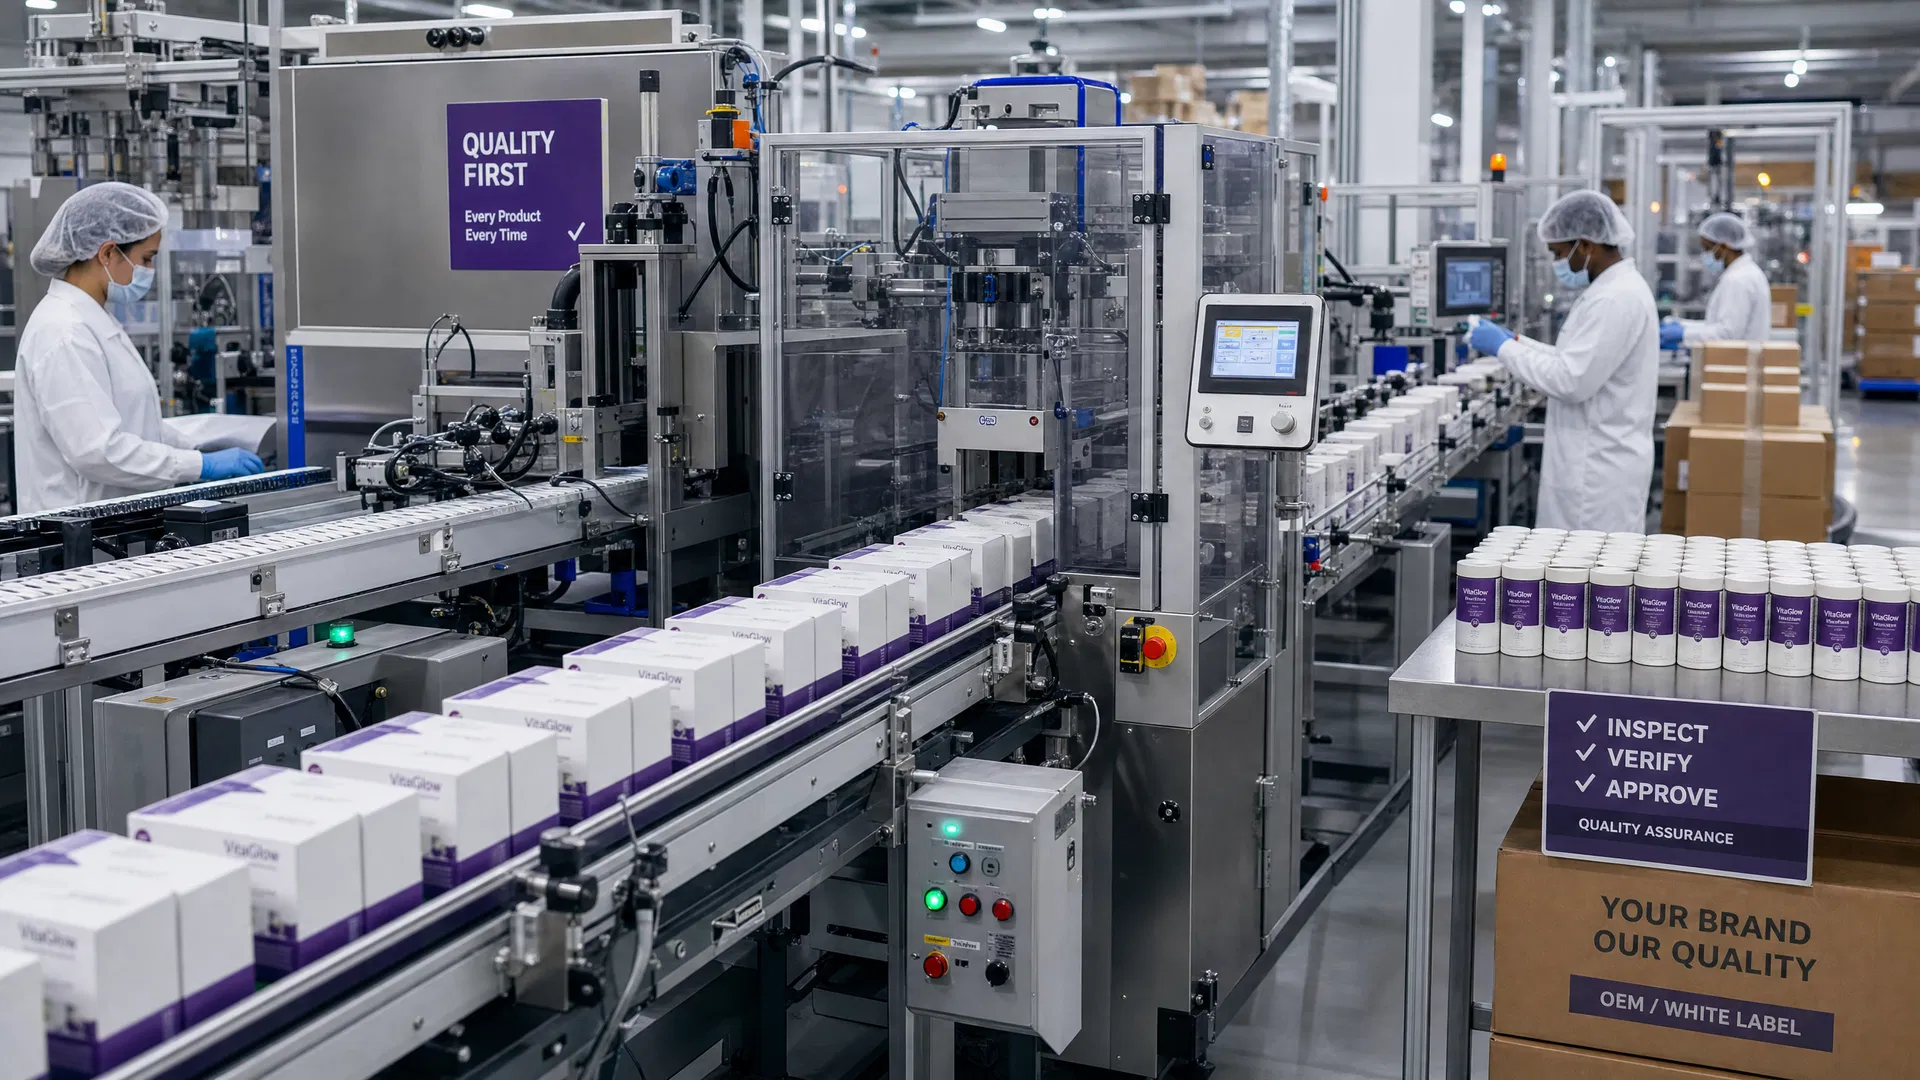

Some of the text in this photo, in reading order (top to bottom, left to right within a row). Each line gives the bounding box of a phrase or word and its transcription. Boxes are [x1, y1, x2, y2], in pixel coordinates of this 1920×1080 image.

[462, 130, 555, 159] QUALITY
[464, 162, 528, 187] FIRST
[465, 209, 541, 226] Every Product
[465, 228, 528, 244] Every Time
[1463, 588, 1489, 596] VitaGlow
[1731, 603, 1759, 612] VitaGlow
[1776, 606, 1804, 616] VitaGlow
[1824, 609, 1853, 619] VitaGlow
[1871, 612, 1900, 622] VitaGlow
[638, 669, 683, 684] VitaGlow
[524, 716, 573, 733] VitaGlow
[1607, 717, 1709, 744] INSPECT
[1607, 747, 1693, 773] VERIFY
[389, 772, 442, 792] VitaGlow
[1605, 779, 1718, 808] APPROVE
[1578, 817, 1734, 845] QUALITY ASSURANCE
[1600, 895, 1811, 945] YOUR BRAND
[1593, 929, 1817, 982] OUR QUALITY
[1600, 990, 1802, 1036] OEM / WHITE LABEL
